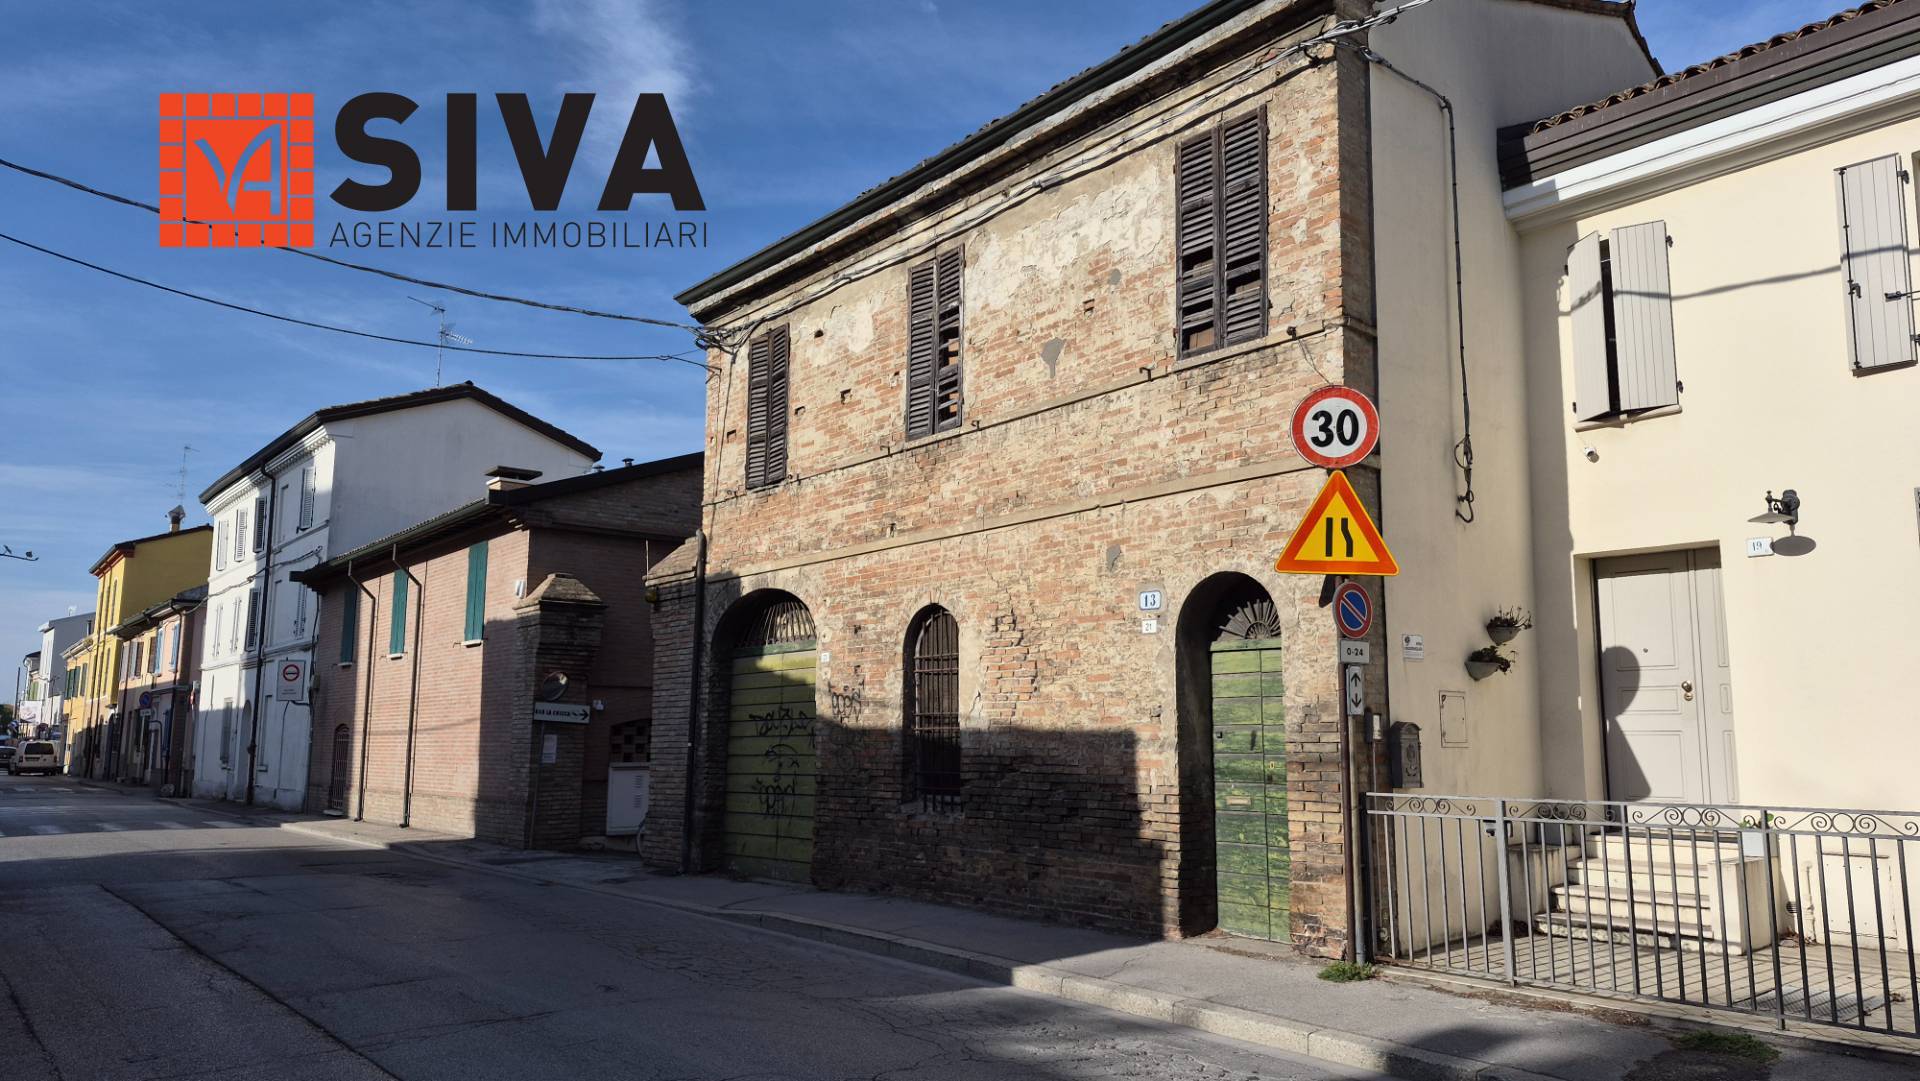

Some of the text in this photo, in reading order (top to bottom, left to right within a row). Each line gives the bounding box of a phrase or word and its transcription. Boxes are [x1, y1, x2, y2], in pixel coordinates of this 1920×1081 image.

[1310, 409, 1360, 447] 30
[1752, 540, 1763, 552] 19
[1144, 593, 1156, 607] 13
[1346, 647, 1364, 656] 0-24
